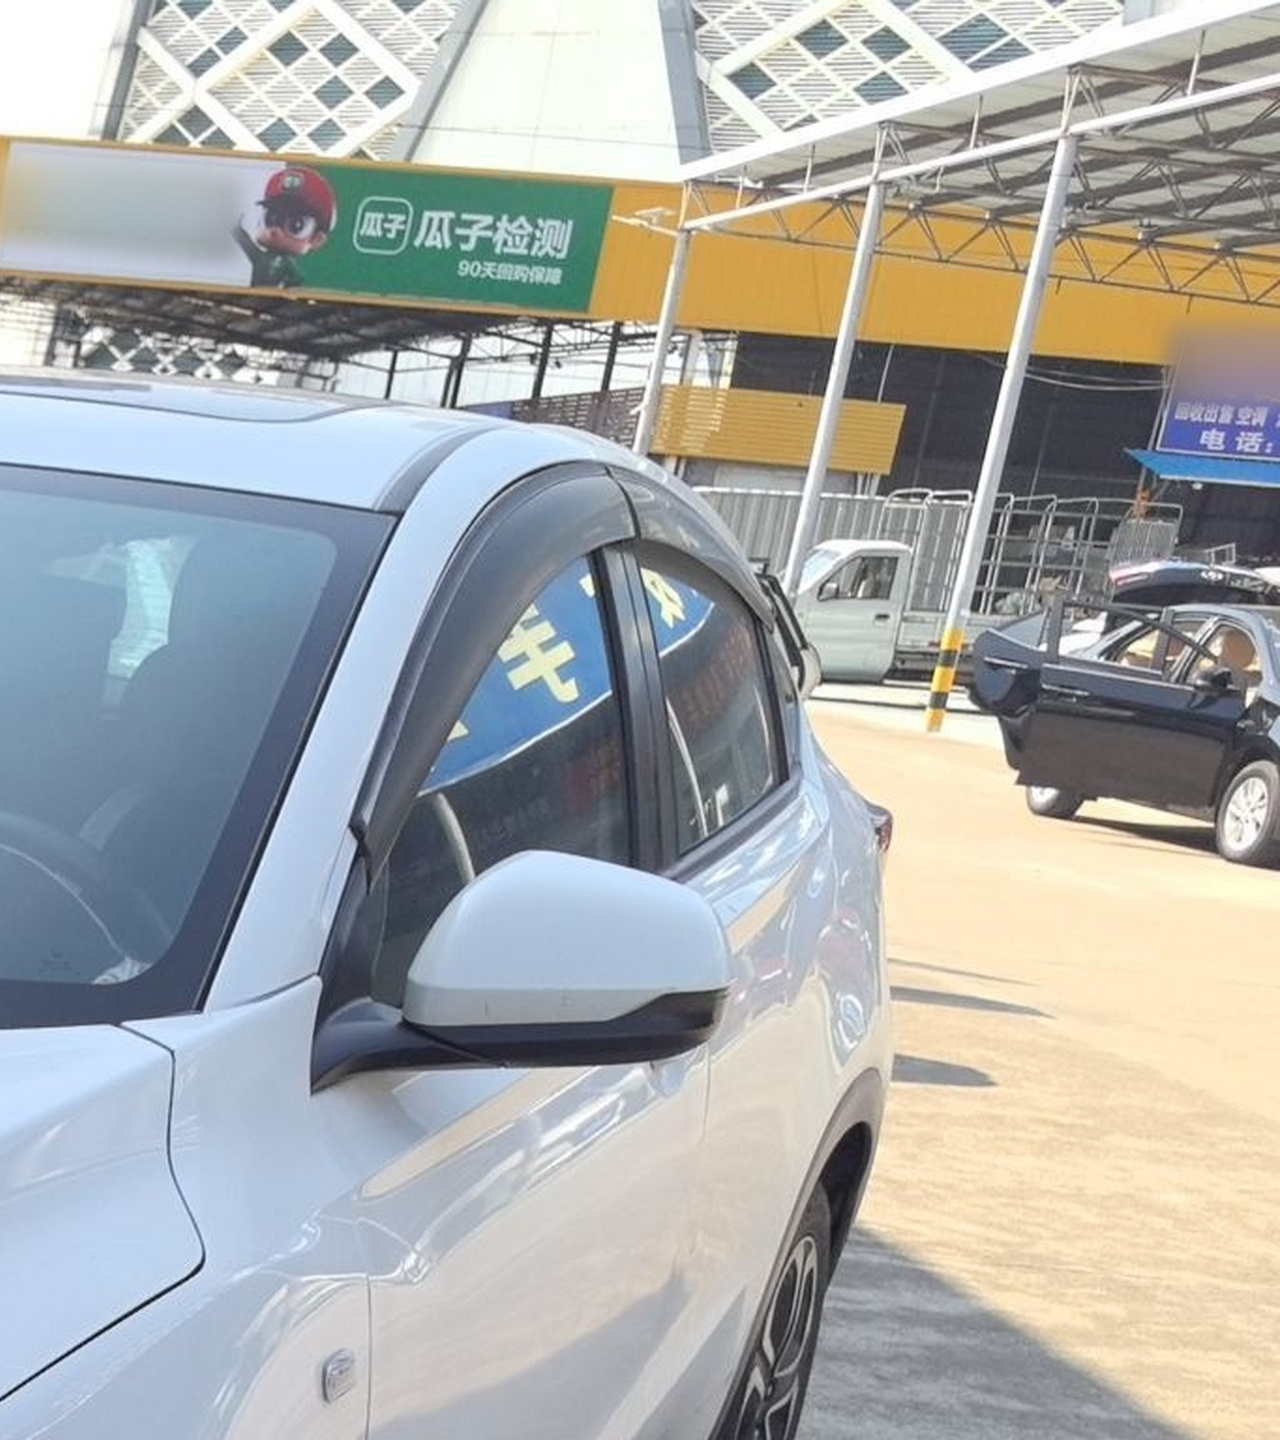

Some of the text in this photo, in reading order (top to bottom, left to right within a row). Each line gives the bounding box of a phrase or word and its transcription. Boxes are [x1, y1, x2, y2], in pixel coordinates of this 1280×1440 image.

[359, 211, 407, 239] 瓜子
[413, 209, 573, 259] 瓜子检测
